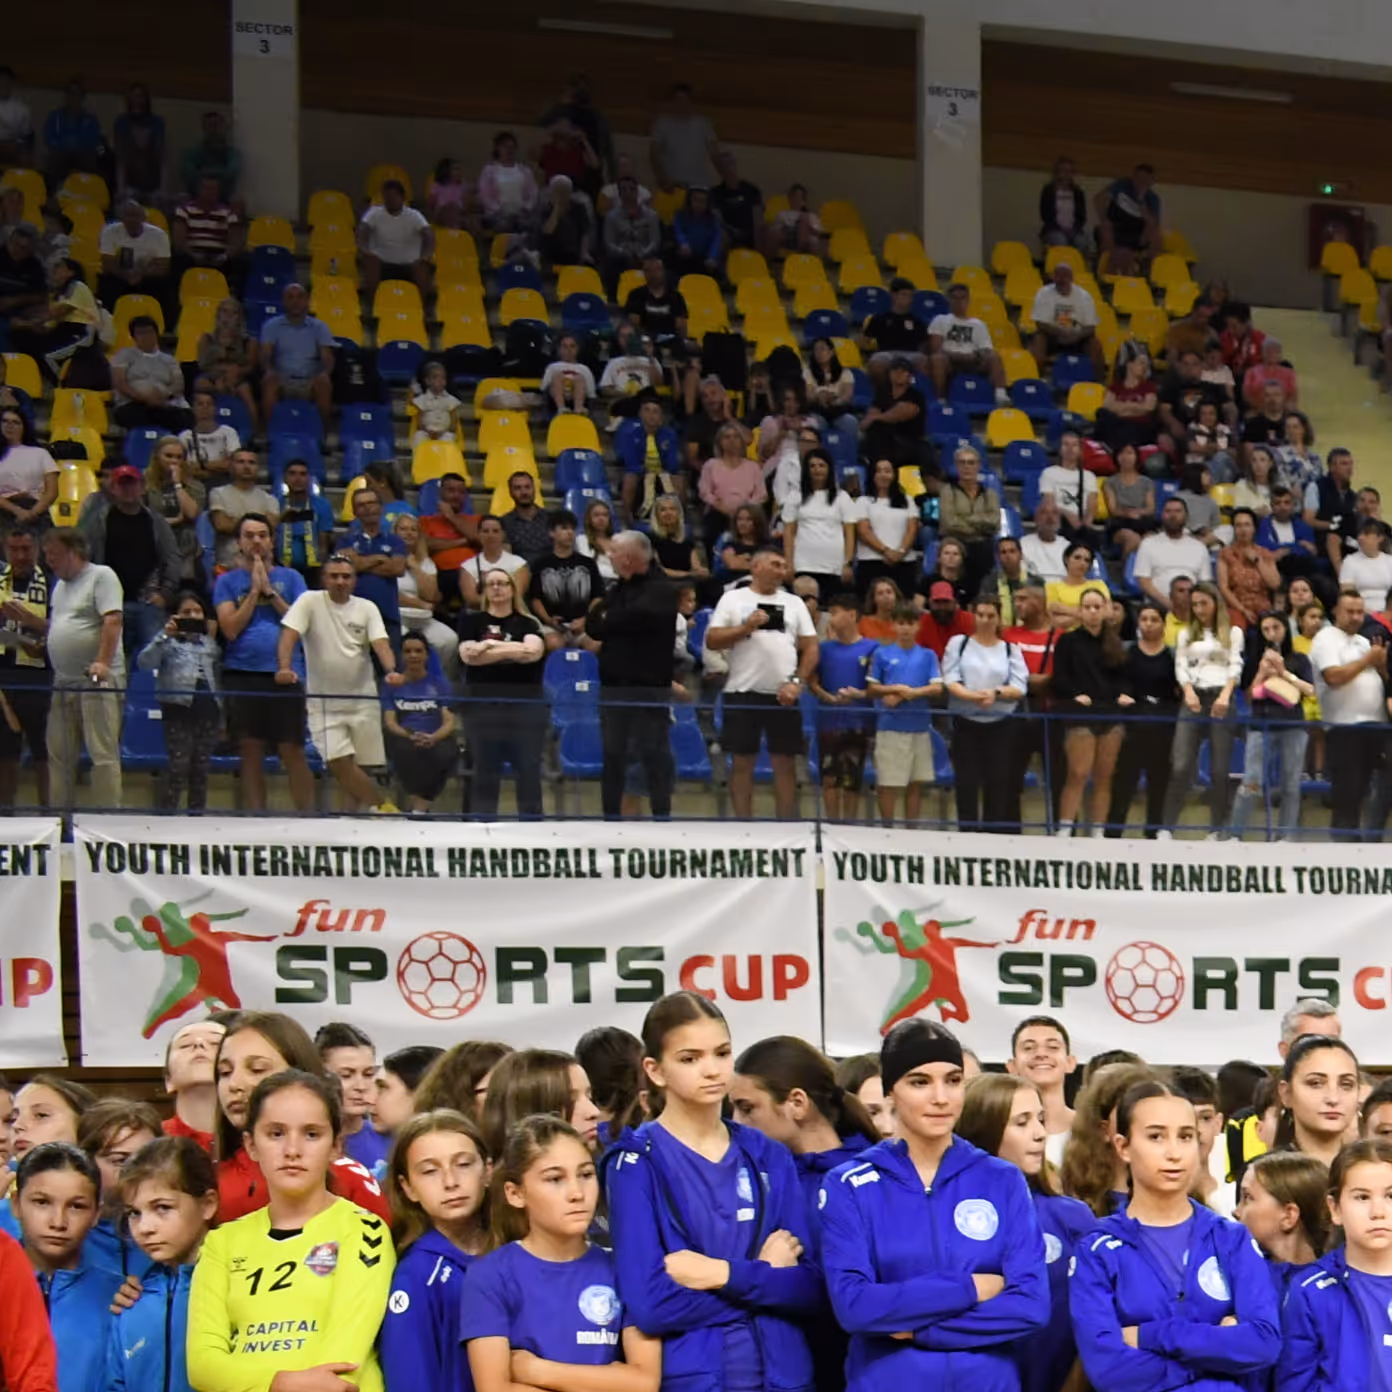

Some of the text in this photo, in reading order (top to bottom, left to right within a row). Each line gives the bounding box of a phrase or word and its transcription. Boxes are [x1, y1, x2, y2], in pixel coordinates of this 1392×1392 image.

[235, 22, 294, 36] SECTOR
[259, 39, 271, 54] 3
[948, 102, 959, 117] 3
[84, 841, 807, 880] YOUTH INTERNATIONAL HANDBALL TOURNAMENT
[833, 851, 926, 885] YOUTH
[933, 855, 1144, 892] INTERNATIONAL
[1151, 862, 1286, 895] HANDBALL
[284, 899, 388, 938] fun
[1006, 909, 1098, 945] fun
[678, 954, 811, 1003] CUP
[245, 1261, 297, 1296] 12
[246, 1320, 318, 1337] CAPITAL
[242, 1339, 306, 1354] INVEST
